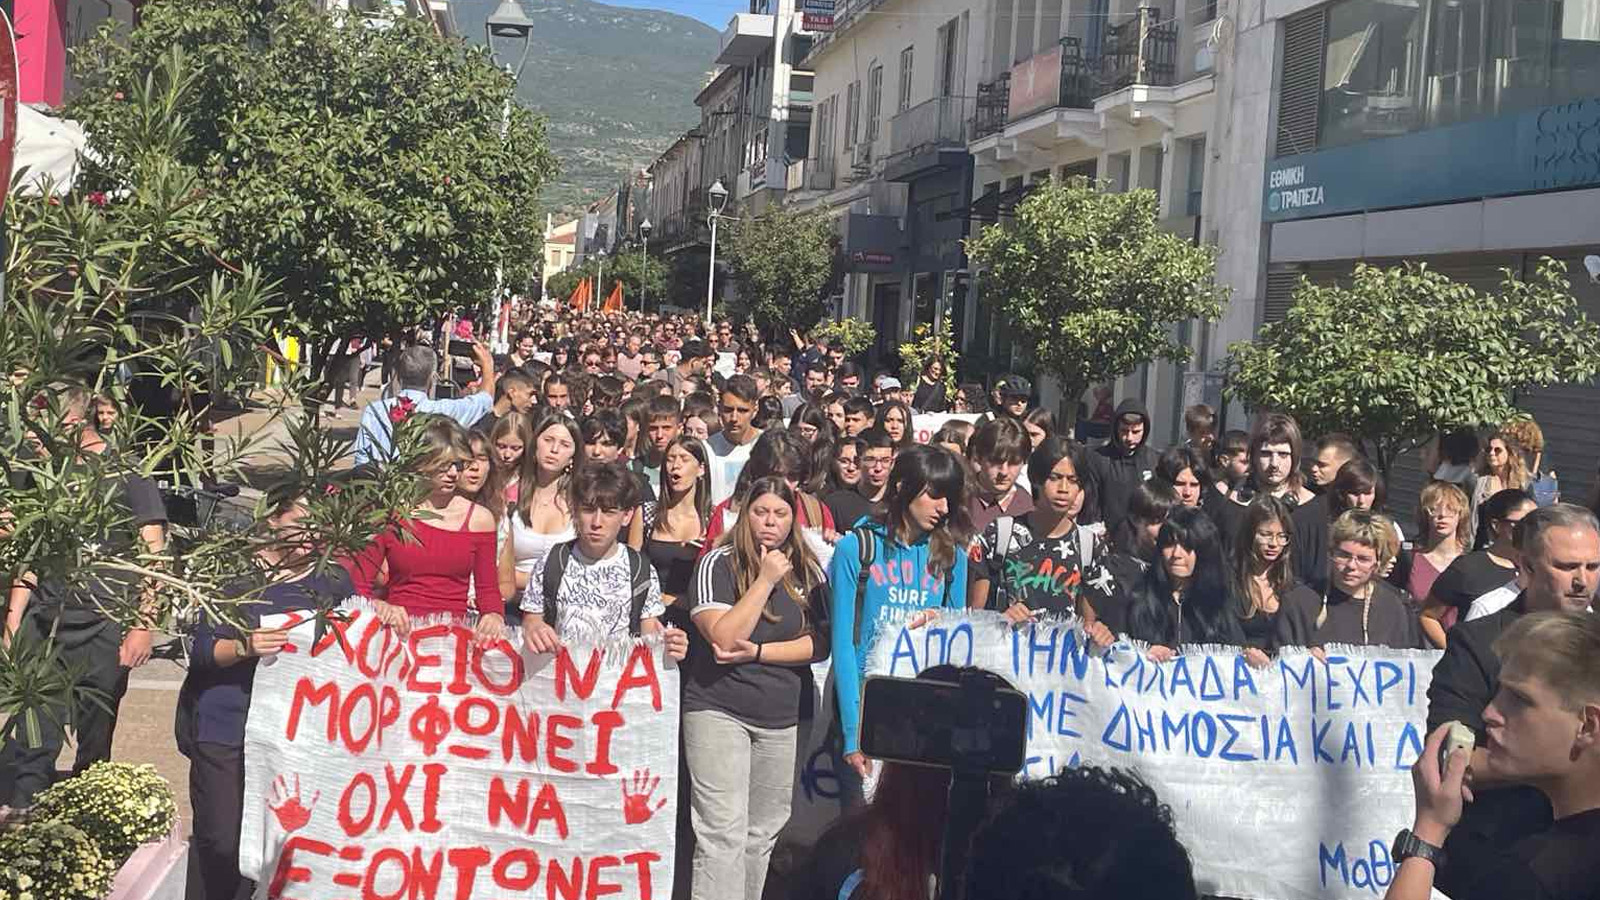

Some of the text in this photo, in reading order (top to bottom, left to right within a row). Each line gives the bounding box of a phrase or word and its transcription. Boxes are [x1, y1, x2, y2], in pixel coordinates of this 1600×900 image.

[1270, 165, 1304, 188] ΕΘΝΙΚΗ
[1281, 185, 1324, 209] ΤΡΑΠΕΖΑ
[888, 586, 929, 606] SURF
[554, 643, 663, 712] ΝΑ
[889, 622, 974, 676] ΑΠΟ
[1279, 656, 1416, 714] ΜΕΧΡΙ
[286, 676, 627, 776] ΜΟΡΦΩΝΕΙ
[1102, 699, 1299, 766] ΔΗΜΟΣΙΑ
[1310, 716, 1376, 768] ΚΑΙ
[337, 761, 570, 840] ΟΧΙ ΝΑ
[1318, 839, 1394, 896] Μαθ
